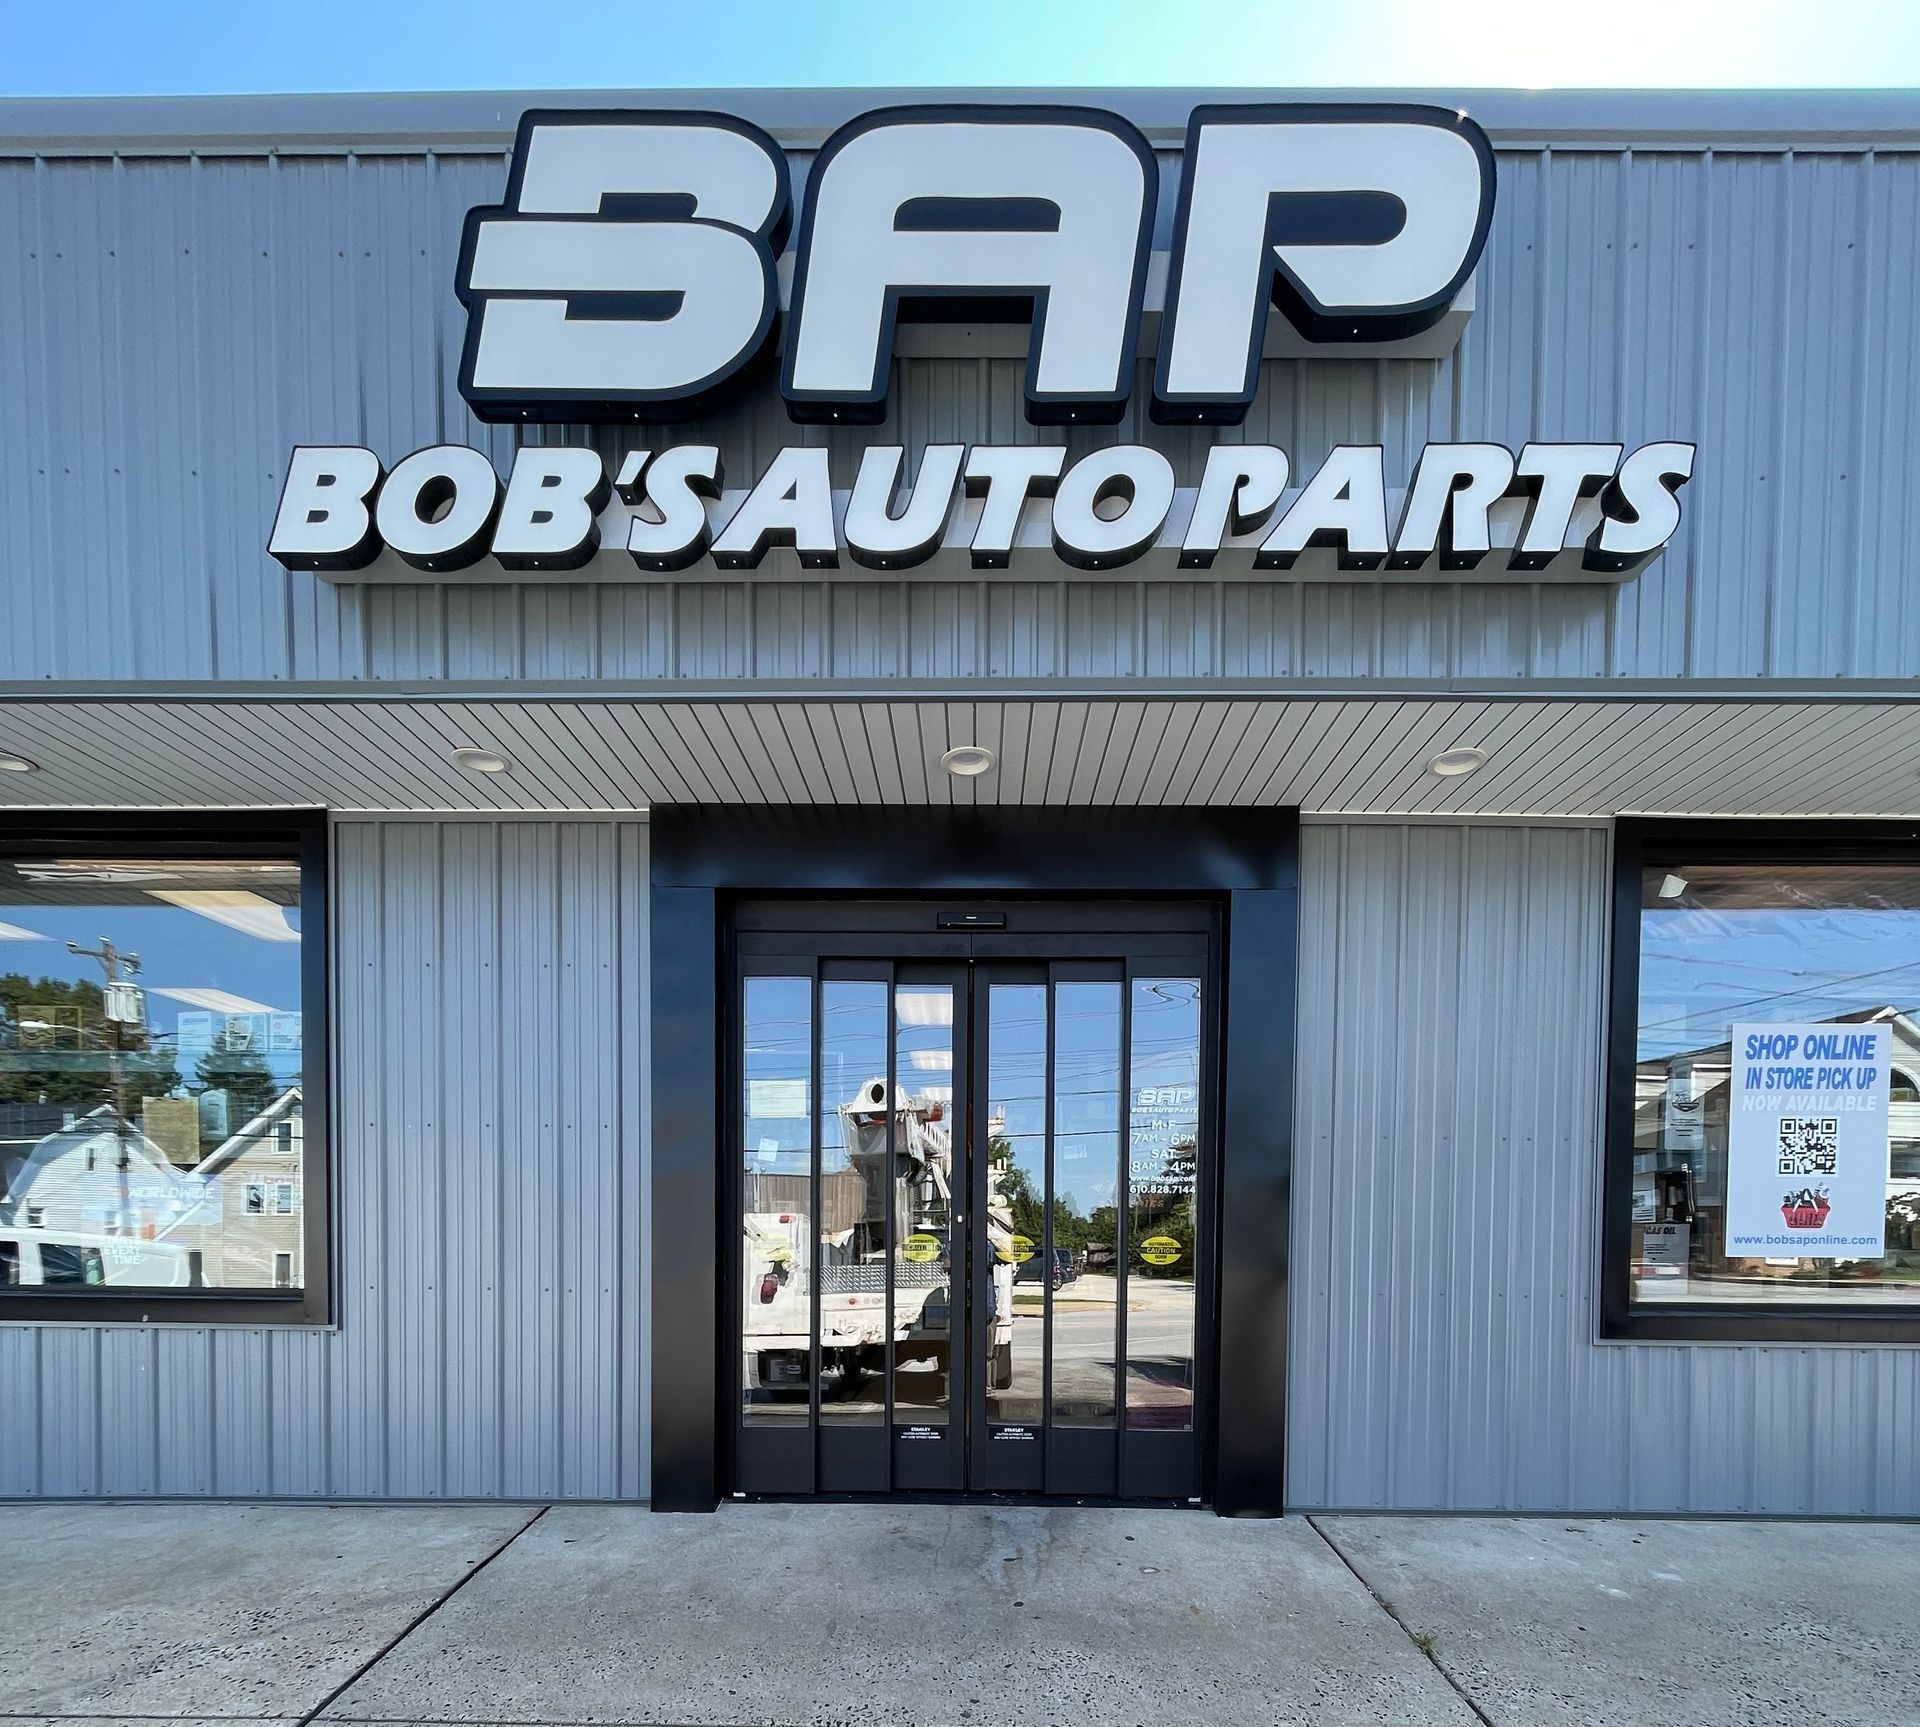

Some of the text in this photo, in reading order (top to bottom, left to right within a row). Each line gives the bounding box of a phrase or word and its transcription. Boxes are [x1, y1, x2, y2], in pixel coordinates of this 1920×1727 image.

[460, 107, 1494, 402] BAP
[268, 444, 720, 560] BOB'S
[1745, 1034, 1877, 1060] SHOP ONLINE
[1745, 1067, 1877, 1090] IN STORE PICK UP
[1137, 1087, 1195, 1106] BAP
[1741, 1095, 1877, 1112] NOW AVAILABLE
[1132, 1132, 1158, 1145] 7AM
[1170, 1133, 1196, 1146] 6PM
[1151, 1148, 1177, 1159] SAT
[1131, 1160, 1158, 1173] 8AM
[1170, 1160, 1196, 1173] 4PM
[1129, 1184, 1196, 1194] 610.828.7144
[1733, 1233, 1878, 1248] www.bobsaponline.com
